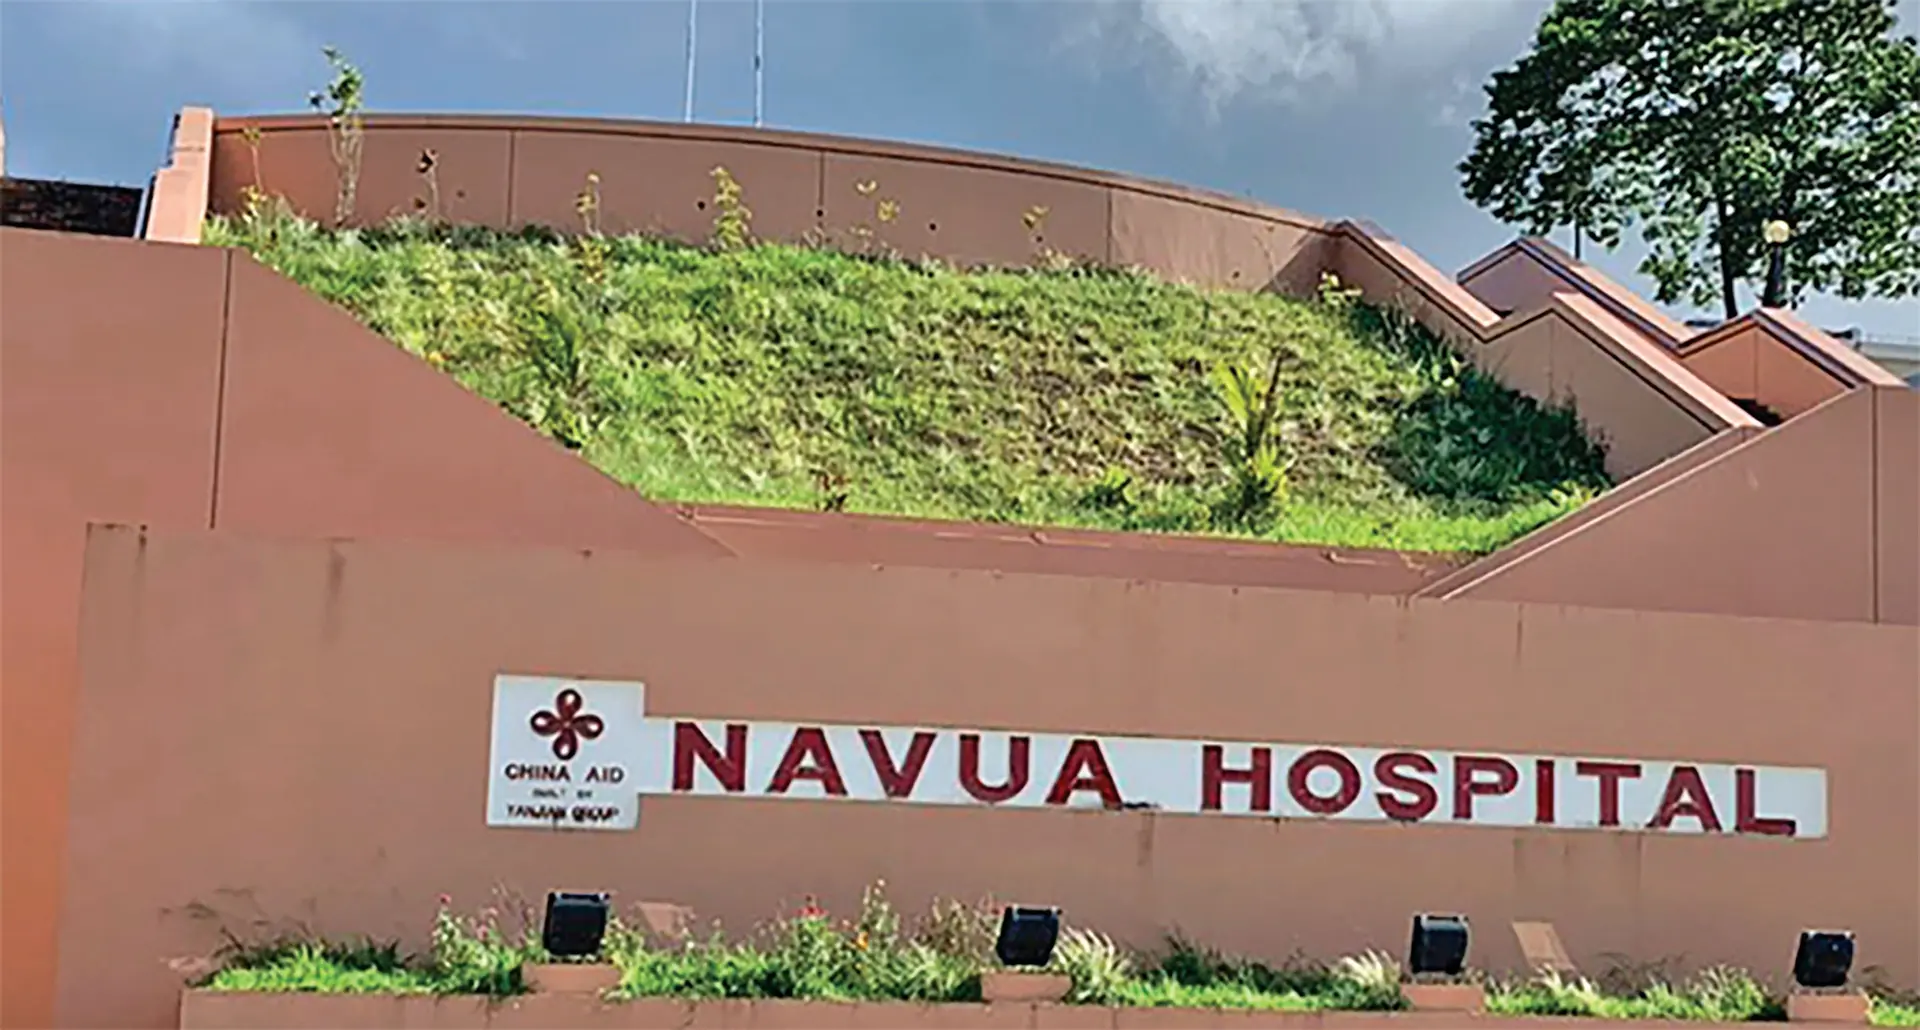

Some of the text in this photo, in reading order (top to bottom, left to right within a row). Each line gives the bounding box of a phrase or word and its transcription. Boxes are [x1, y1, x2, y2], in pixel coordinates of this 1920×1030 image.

[505, 764, 624, 784] CHINA AID
[672, 721, 1796, 837] NAVUA HOSPITAL
